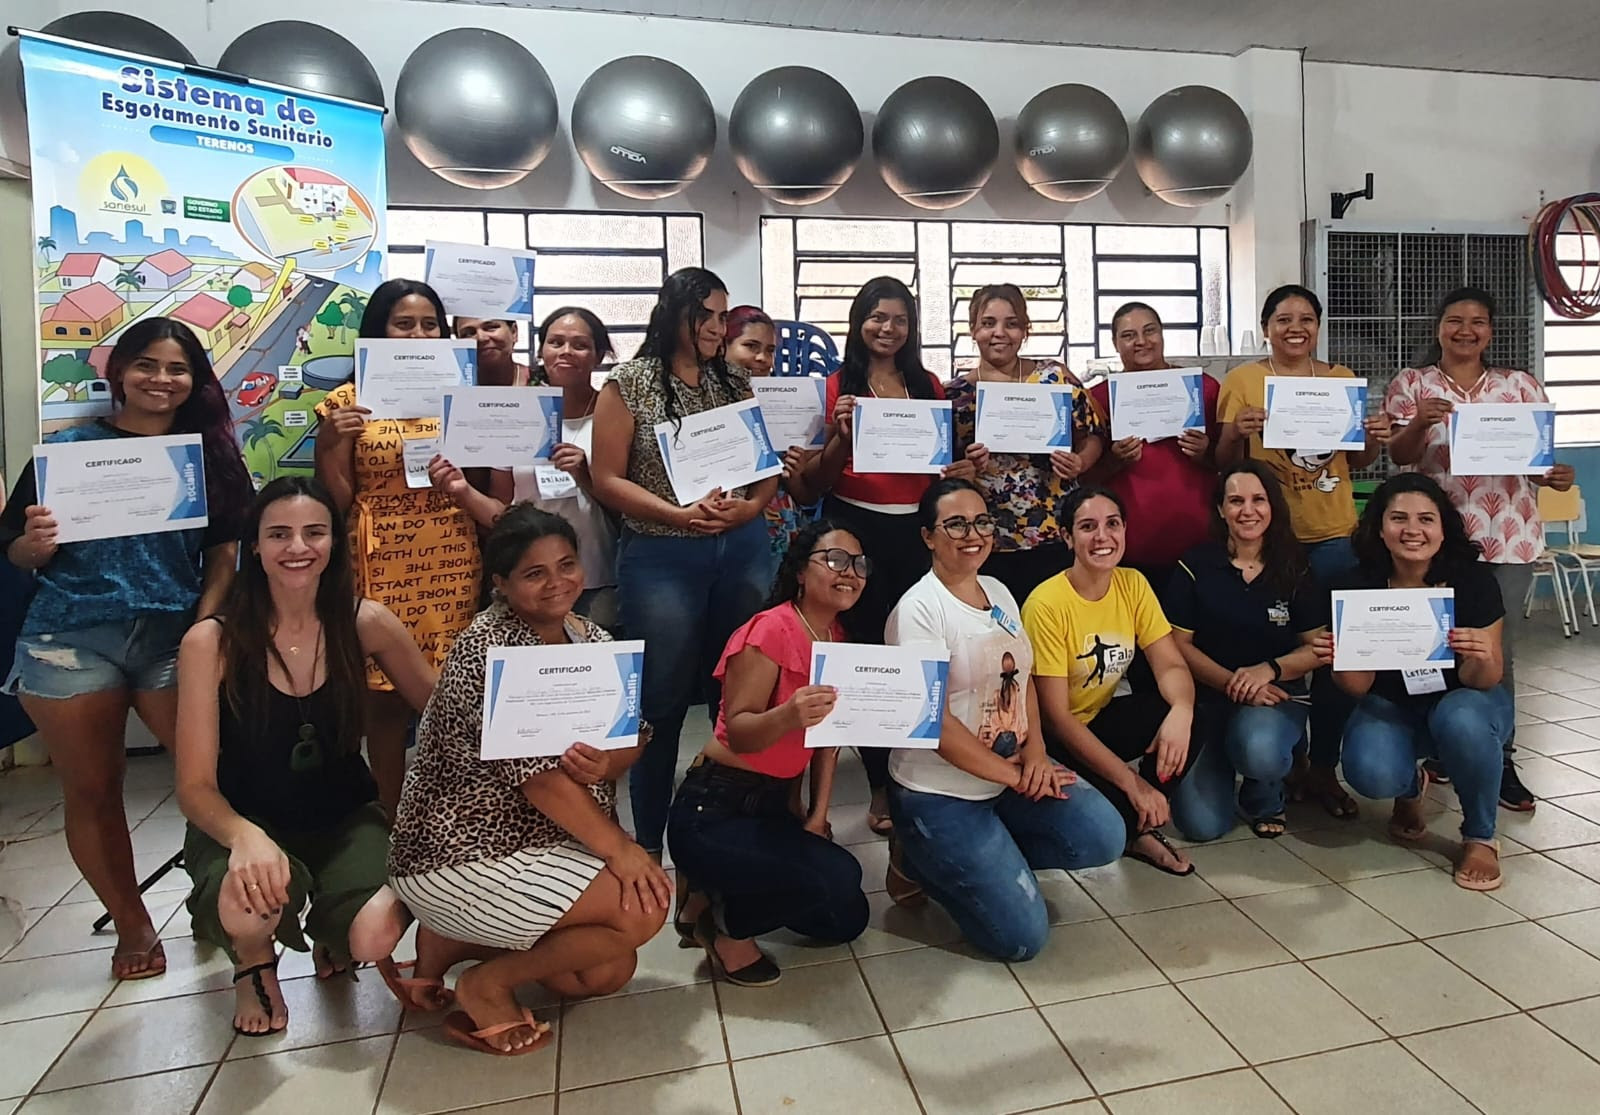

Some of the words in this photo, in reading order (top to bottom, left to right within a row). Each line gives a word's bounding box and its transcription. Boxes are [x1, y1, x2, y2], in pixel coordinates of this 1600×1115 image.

[121, 66, 264, 116] Sistema
[277, 97, 316, 125] de
[102, 92, 240, 132] Esgotamento
[196, 135, 255, 154] TERENOS
[103, 201, 146, 212] sanesul
[690, 423, 727, 438] CERTIFICADO
[85, 457, 143, 468] CERTIFICADO
[403, 519, 425, 529] DO
[430, 516, 449, 526] TO
[418, 546, 438, 557] UT
[441, 542, 467, 554] THIS
[404, 561, 434, 574] THE
[438, 558, 472, 570] MORE
[382, 593, 412, 606] THE
[416, 587, 457, 601] MORE
[406, 605, 428, 617] DO
[432, 601, 451, 612] TO
[538, 665, 593, 676] CERTIFICADO
[854, 666, 901, 675] CERTIFICADO
